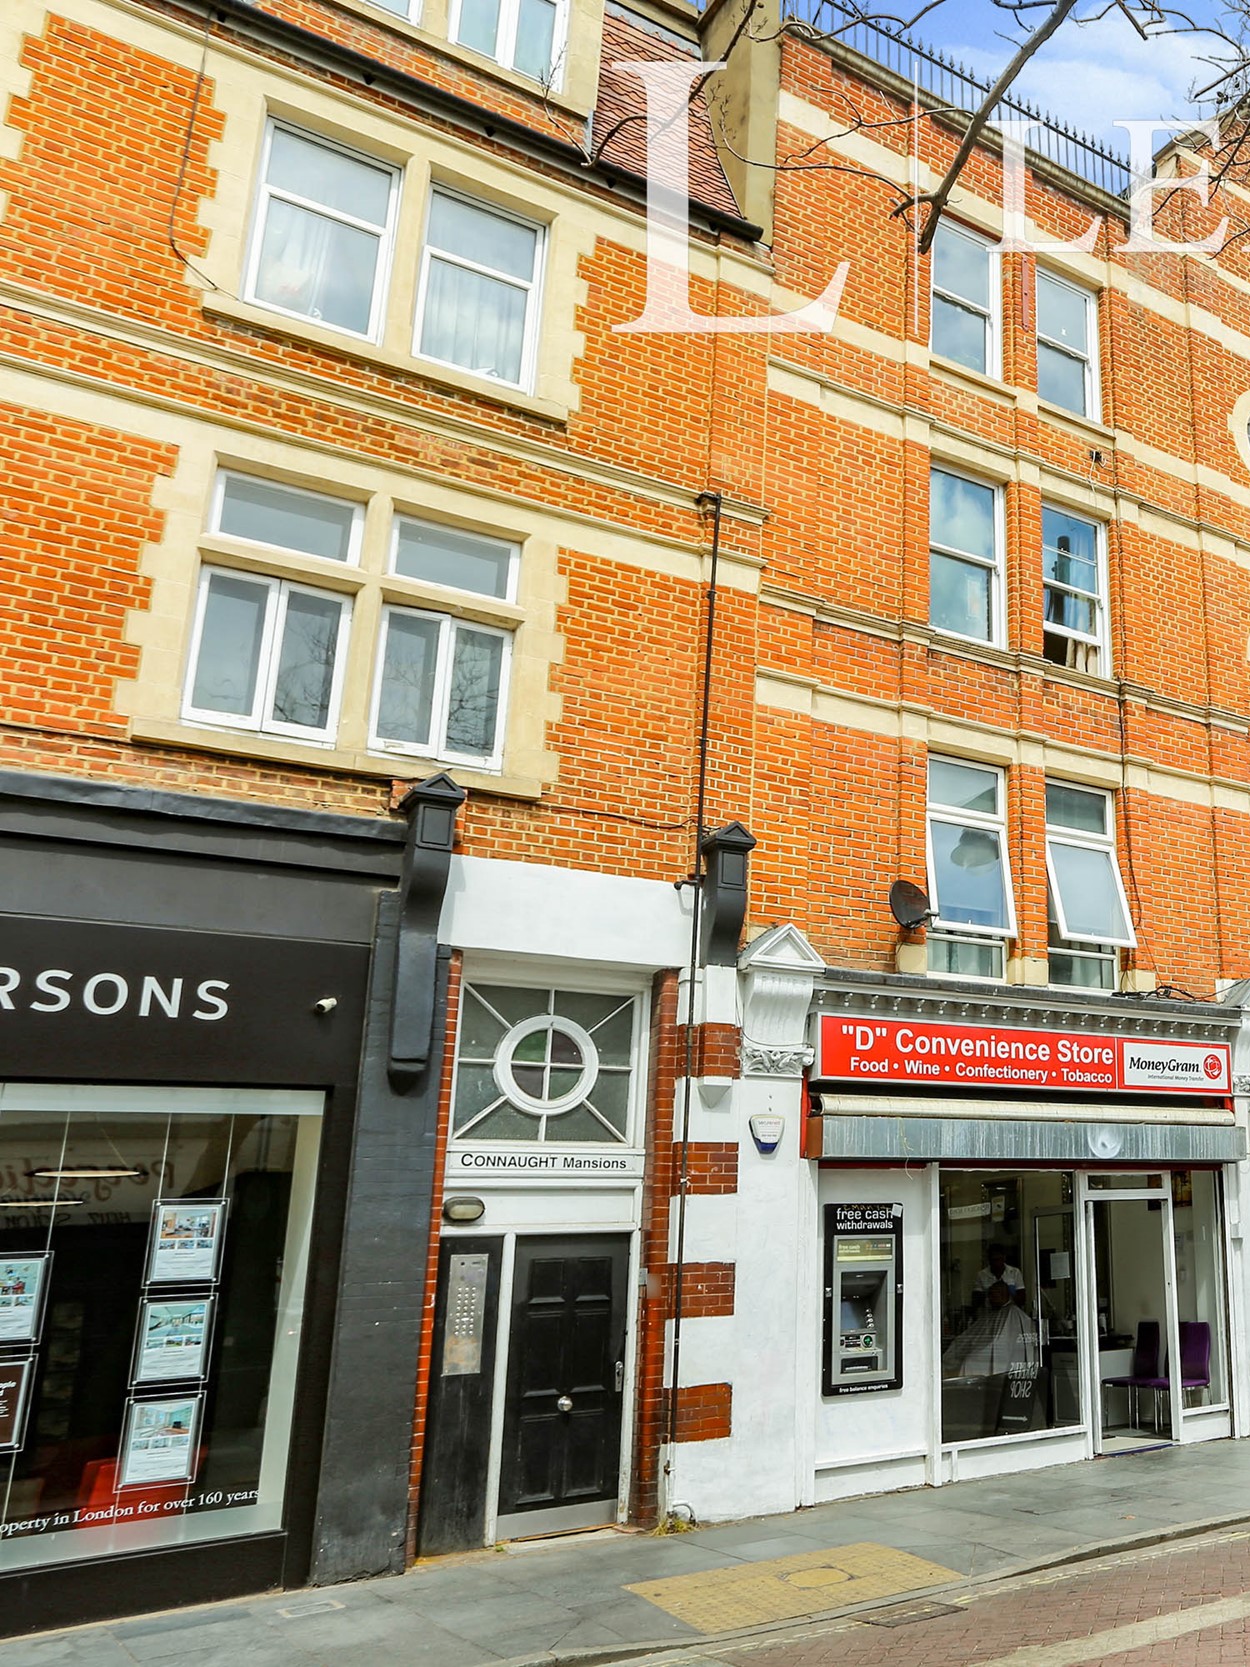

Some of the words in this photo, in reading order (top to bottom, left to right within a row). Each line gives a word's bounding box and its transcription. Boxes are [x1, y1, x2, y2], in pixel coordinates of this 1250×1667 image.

[841, 1024, 887, 1050] "D"
[895, 1028, 1050, 1061] Convenience
[1057, 1039, 1114, 1064] Store
[850, 1056, 889, 1073] Food
[904, 1059, 940, 1075] Wine
[955, 1062, 1048, 1083] Confectionery
[1061, 1068, 1112, 1084] Tobacco
[1129, 1056, 1199, 1074] MoneyGram
[461, 1153, 558, 1168] CONNAUGHT
[562, 1156, 627, 1169] Mansions
[836, 1207, 862, 1220] free
[865, 1207, 894, 1219] cash
[836, 1219, 894, 1230] withdrawals
[53, 1512, 70, 1526] in
[72, 1505, 134, 1524] London
[137, 1501, 160, 1514] for
[163, 1498, 195, 1511] over
[198, 1491, 223, 1506] 160
[226, 1488, 260, 1506] years
